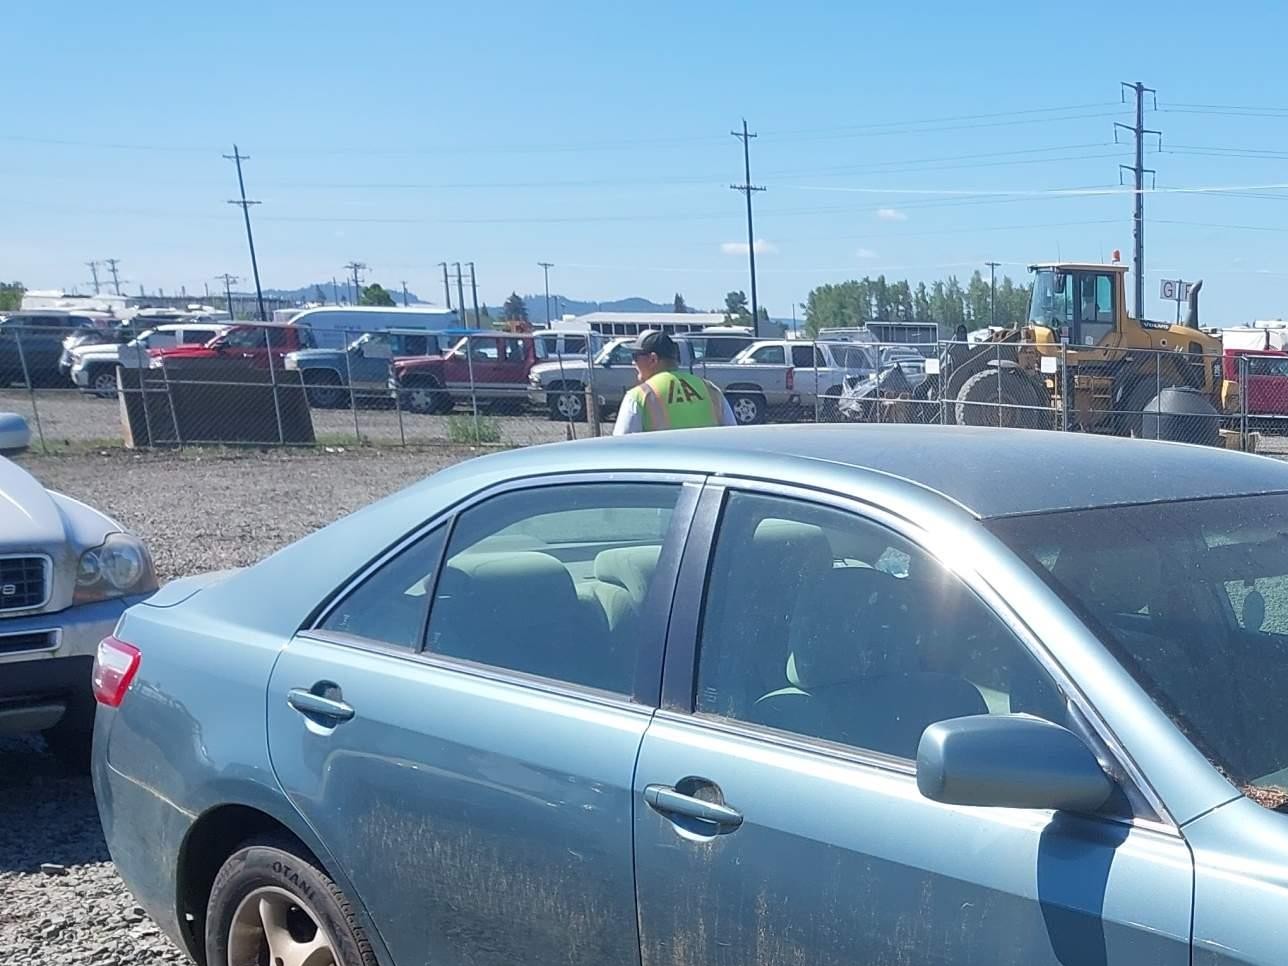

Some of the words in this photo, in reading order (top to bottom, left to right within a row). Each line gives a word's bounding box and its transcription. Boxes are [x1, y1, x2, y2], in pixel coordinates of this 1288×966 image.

[1164, 281, 1173, 298] G
[1143, 322, 1169, 330] VOLVO
[668, 378, 704, 404] IAA
[272, 861, 317, 901] OTANI
